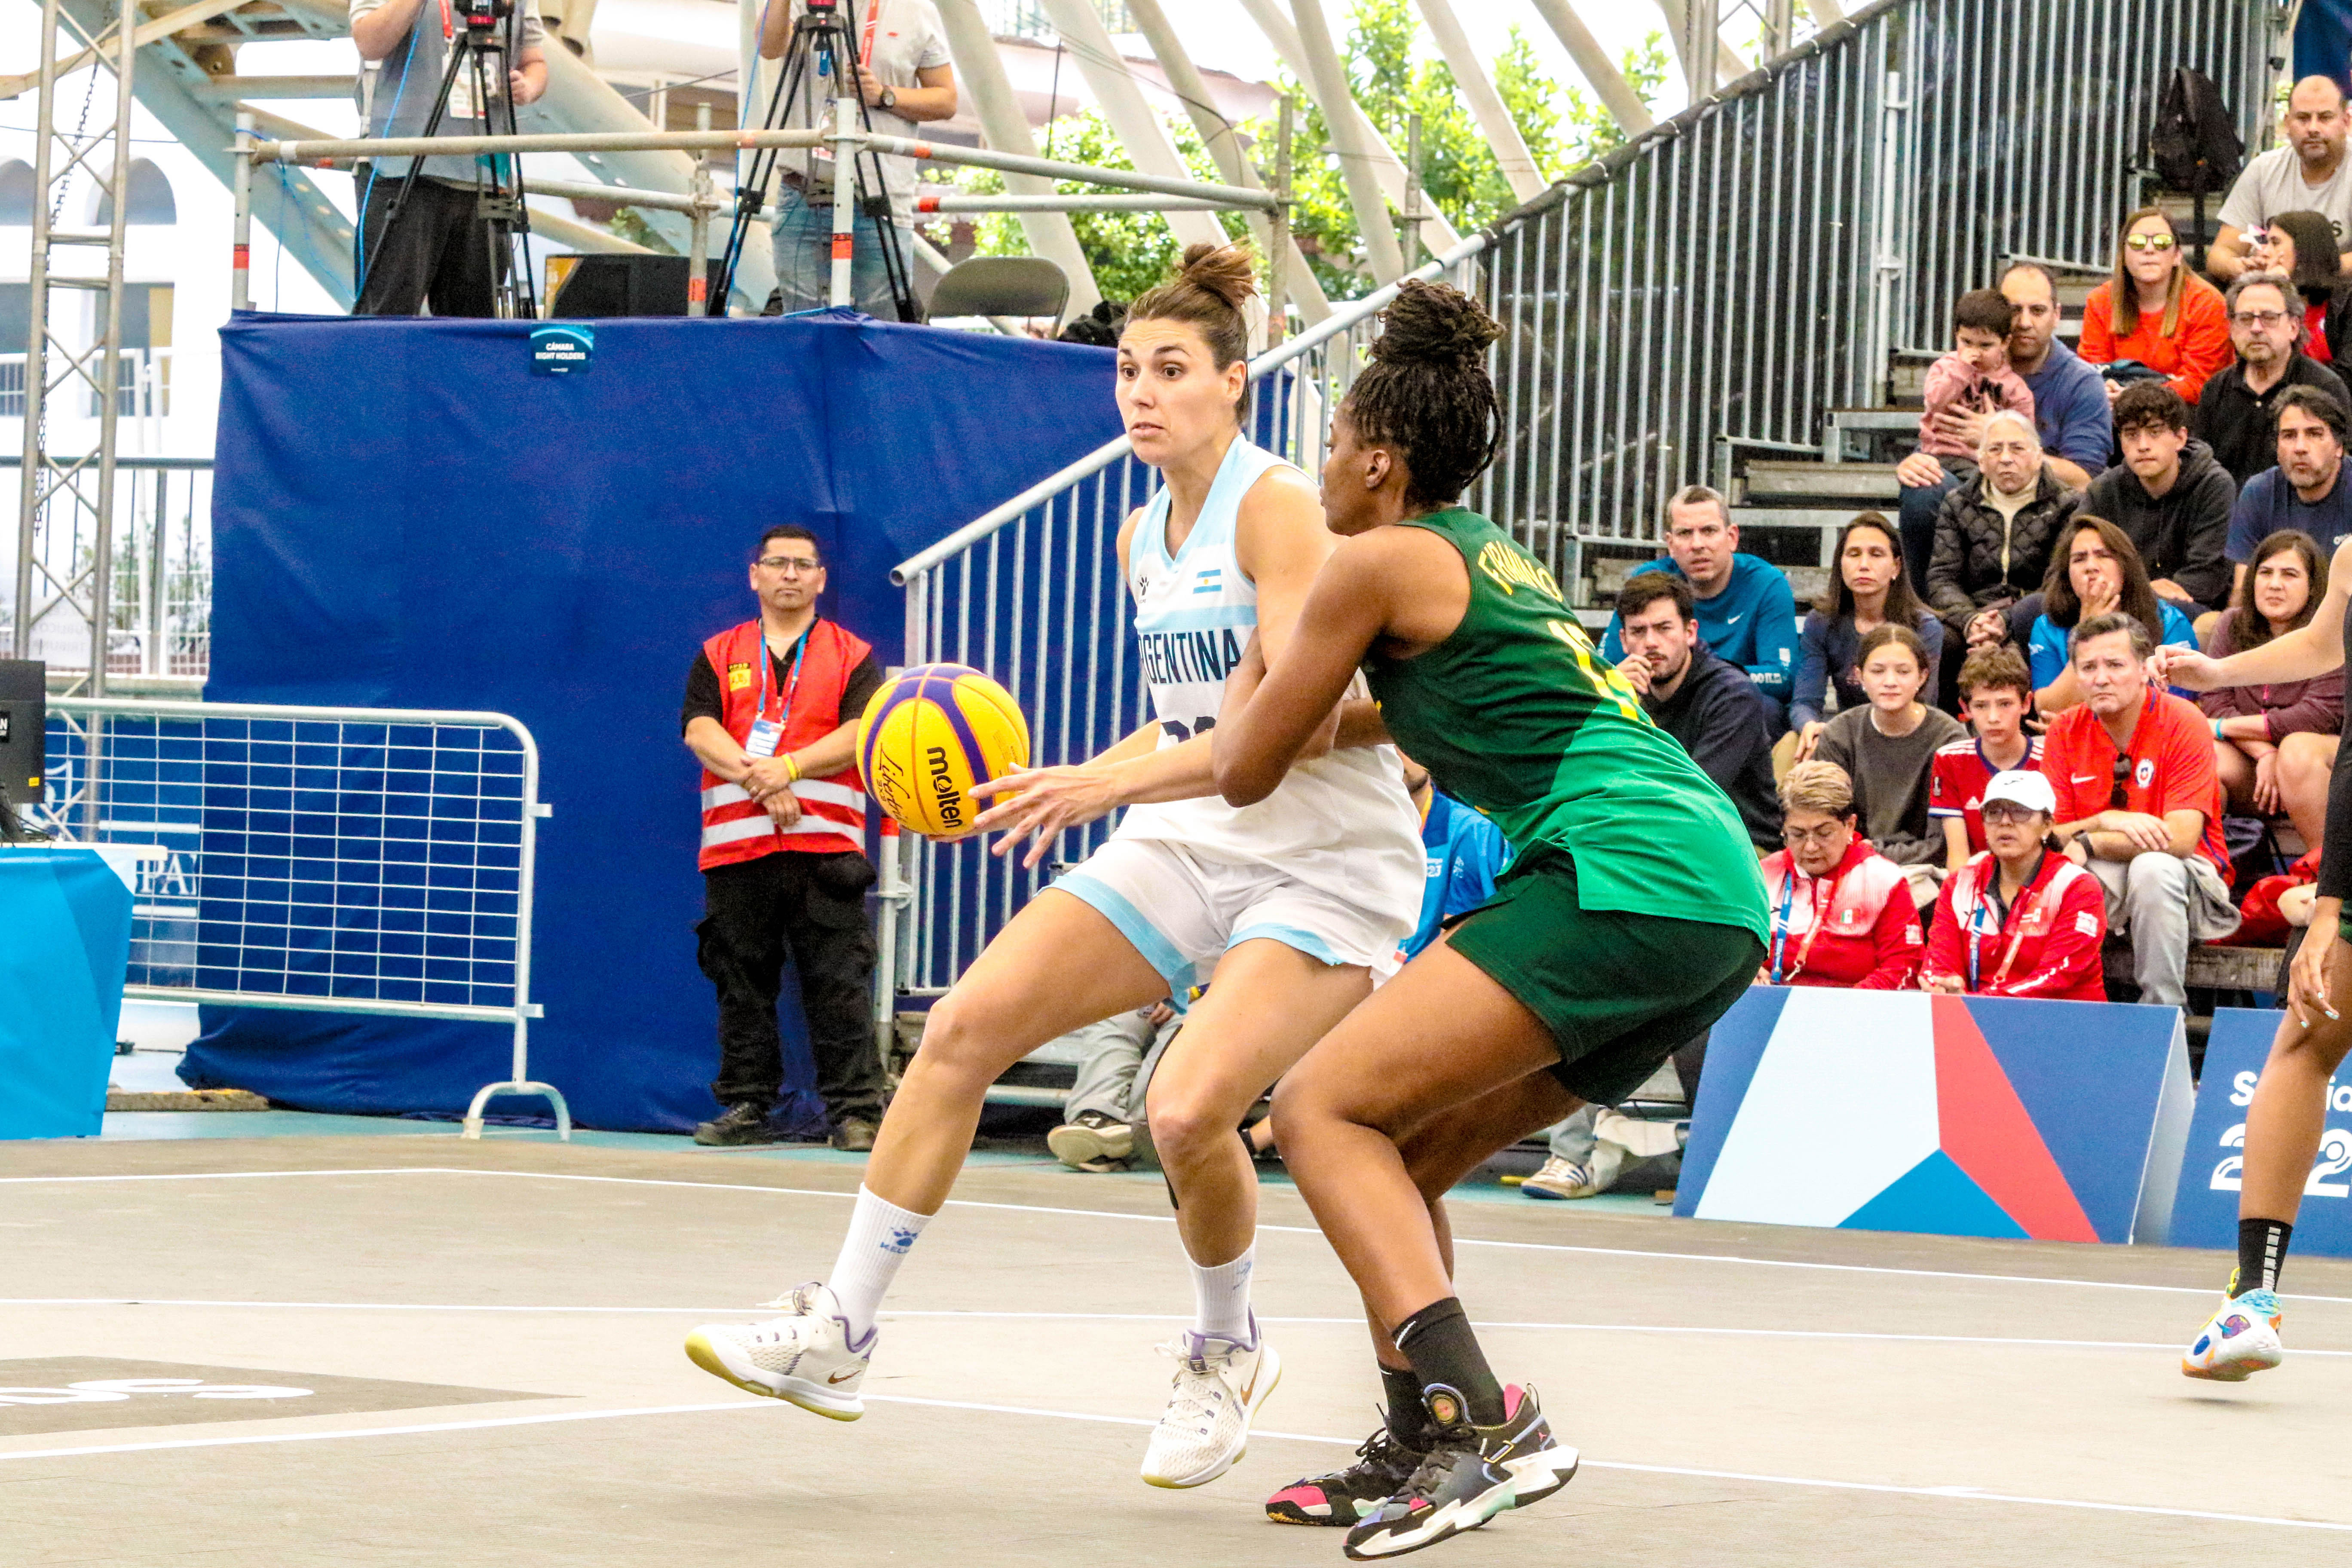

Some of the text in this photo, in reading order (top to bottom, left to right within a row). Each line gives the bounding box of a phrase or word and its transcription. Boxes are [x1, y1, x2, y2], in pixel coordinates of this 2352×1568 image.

[545, 342, 574, 351] CÁMARA
[535, 352, 585, 360] RIGHT HOLDERS
[927, 747, 963, 828] molten
